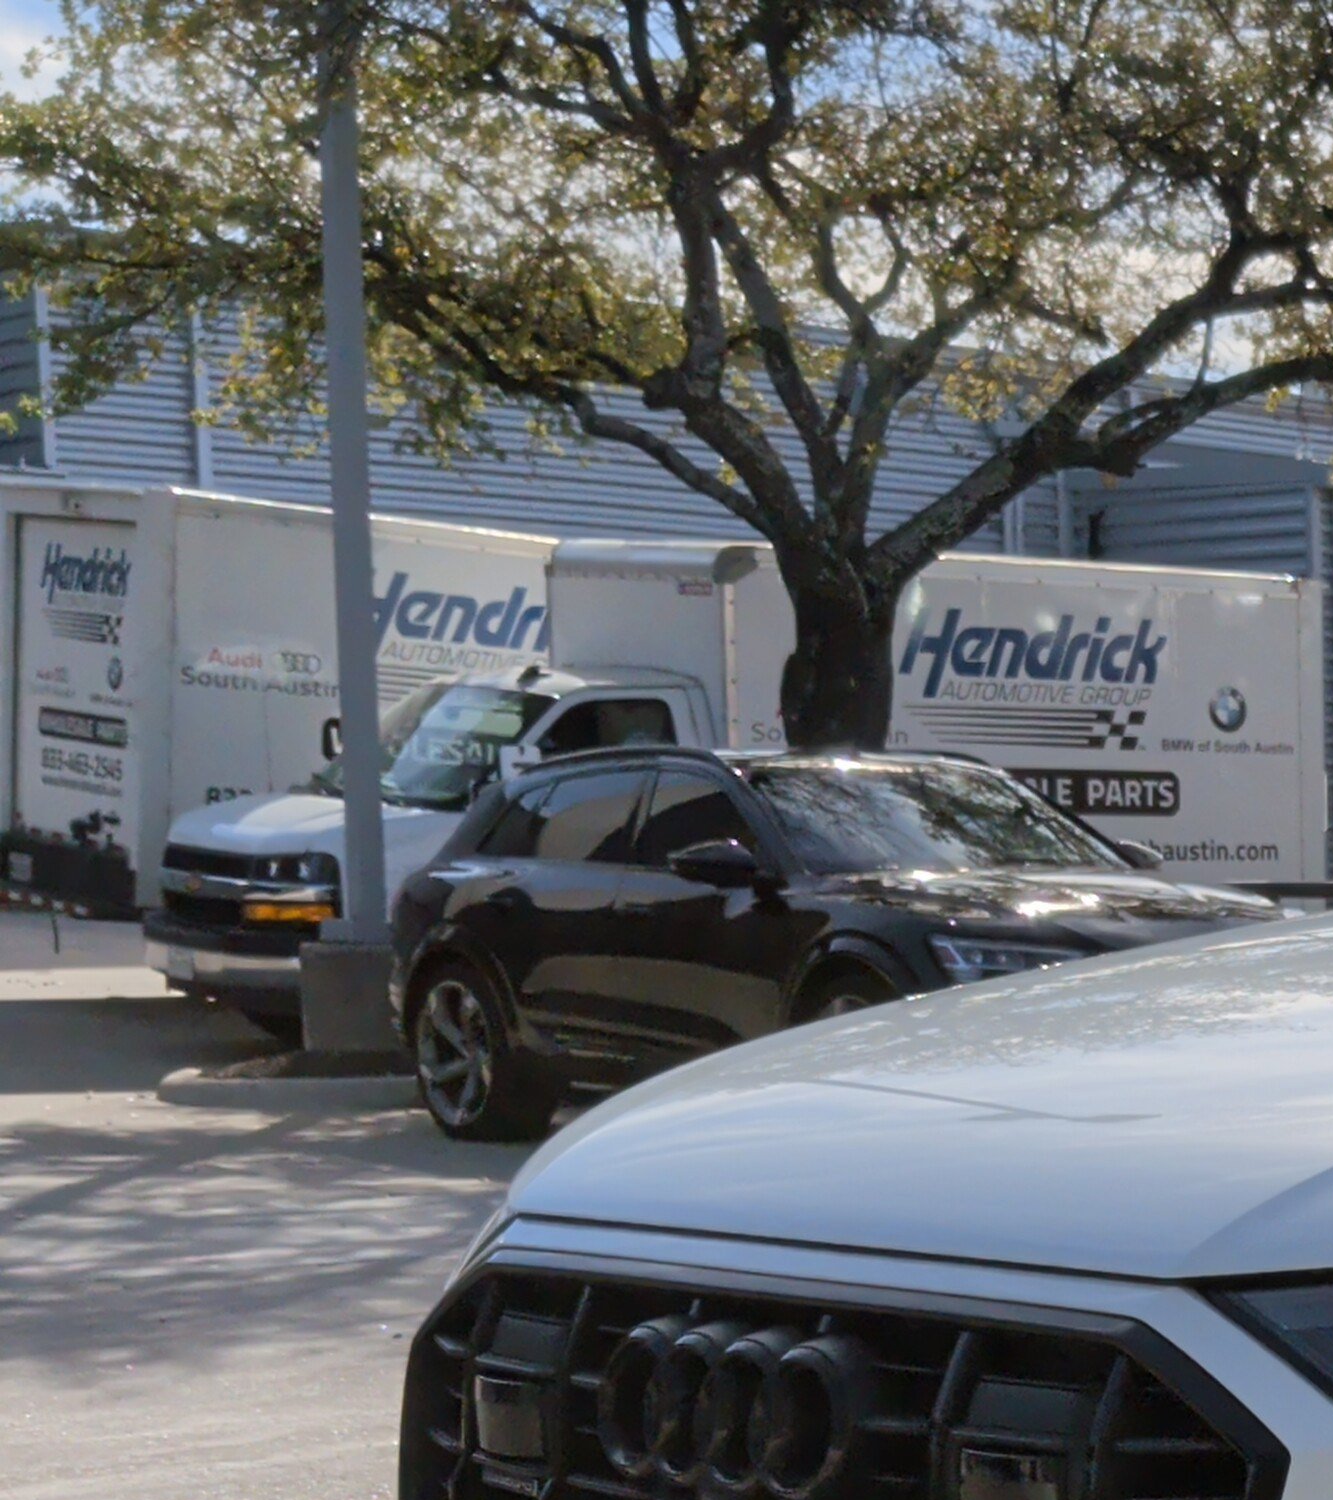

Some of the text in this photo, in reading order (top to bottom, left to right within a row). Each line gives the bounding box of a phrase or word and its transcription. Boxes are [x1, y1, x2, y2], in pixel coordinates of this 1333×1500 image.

[208, 647, 263, 669] Audi
[898, 608, 1167, 698] Hendrick
[179, 665, 257, 692] South
[940, 680, 1152, 707] AUTOMOTIVE GROUP
[1161, 739, 1194, 753] BMW
[1198, 740, 1211, 753] of
[1214, 740, 1250, 754] South
[1254, 742, 1295, 755] Austin
[1086, 778, 1176, 809] PARTS
